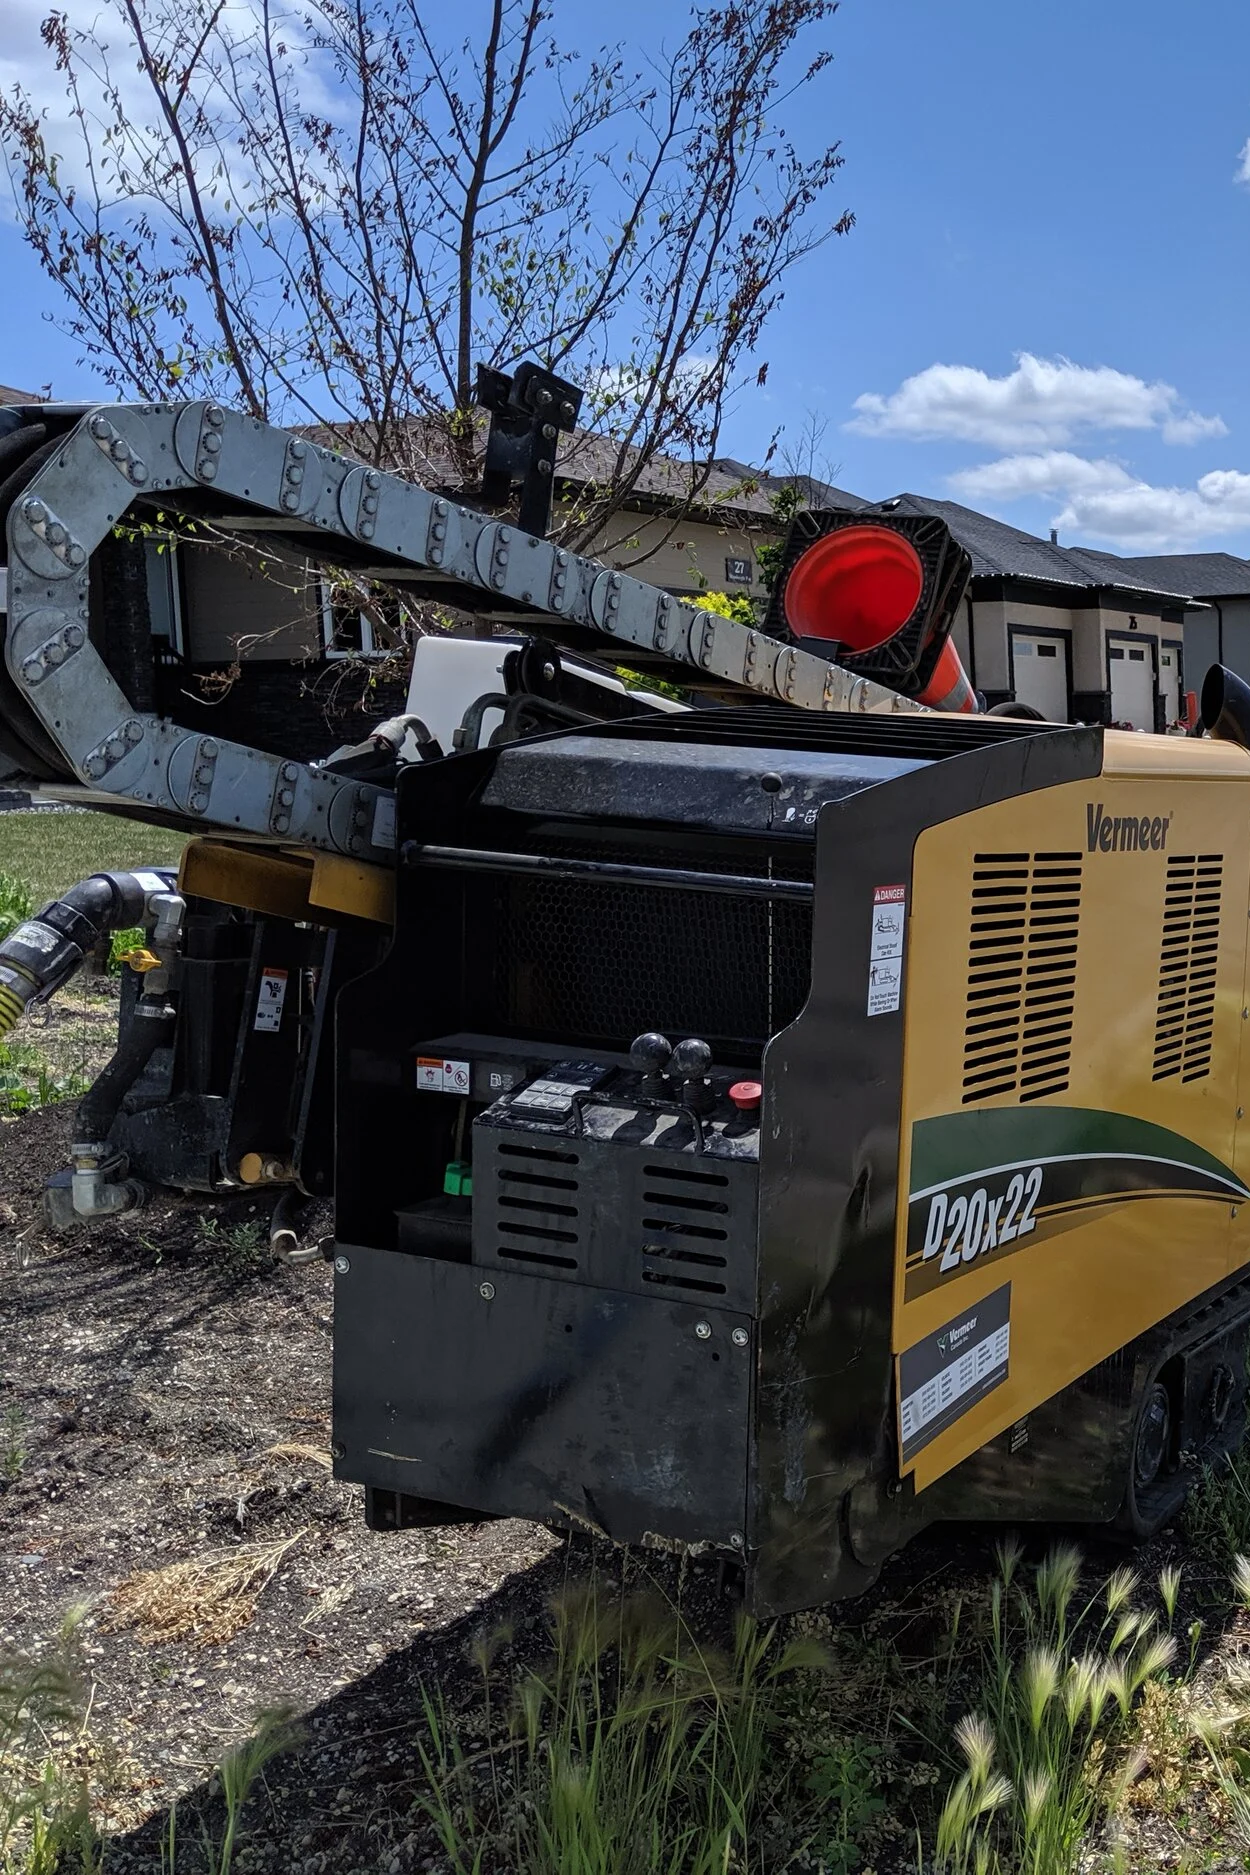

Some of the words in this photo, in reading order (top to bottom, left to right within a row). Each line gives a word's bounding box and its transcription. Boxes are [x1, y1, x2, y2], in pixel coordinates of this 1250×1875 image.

[734, 560, 745, 574] 27
[1087, 803, 1170, 852] Vermeer
[880, 888, 905, 900] DANGER
[922, 1166, 1044, 1274] D20x22
[949, 1317, 978, 1343] Vermeer
